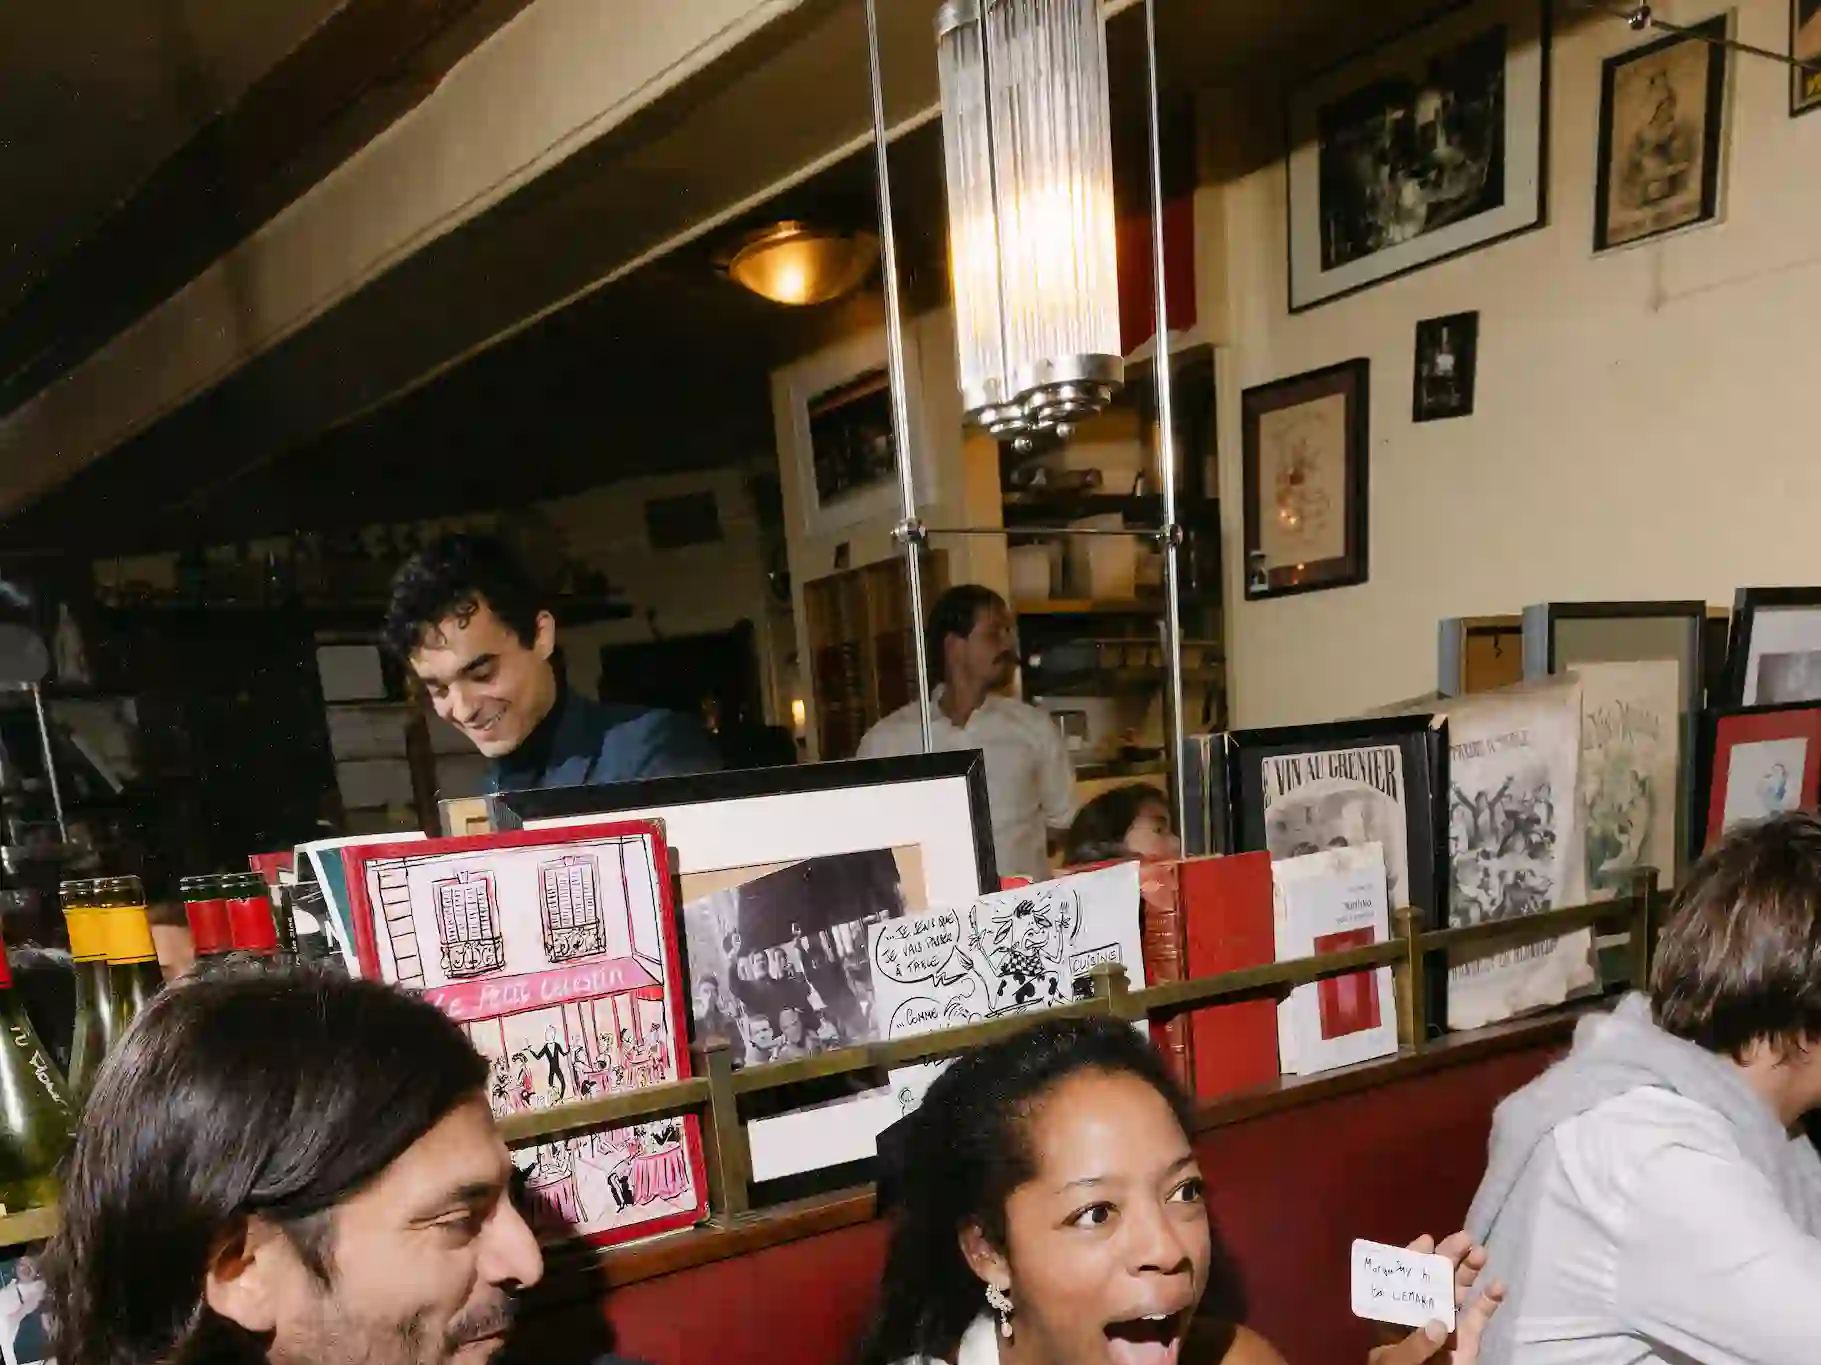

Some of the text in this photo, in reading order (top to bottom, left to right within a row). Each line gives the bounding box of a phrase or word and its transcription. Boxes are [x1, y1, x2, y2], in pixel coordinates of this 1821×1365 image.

[1274, 759, 1301, 795] VIN
[1306, 755, 1324, 780] AU
[1328, 748, 1398, 804] GRENIER
